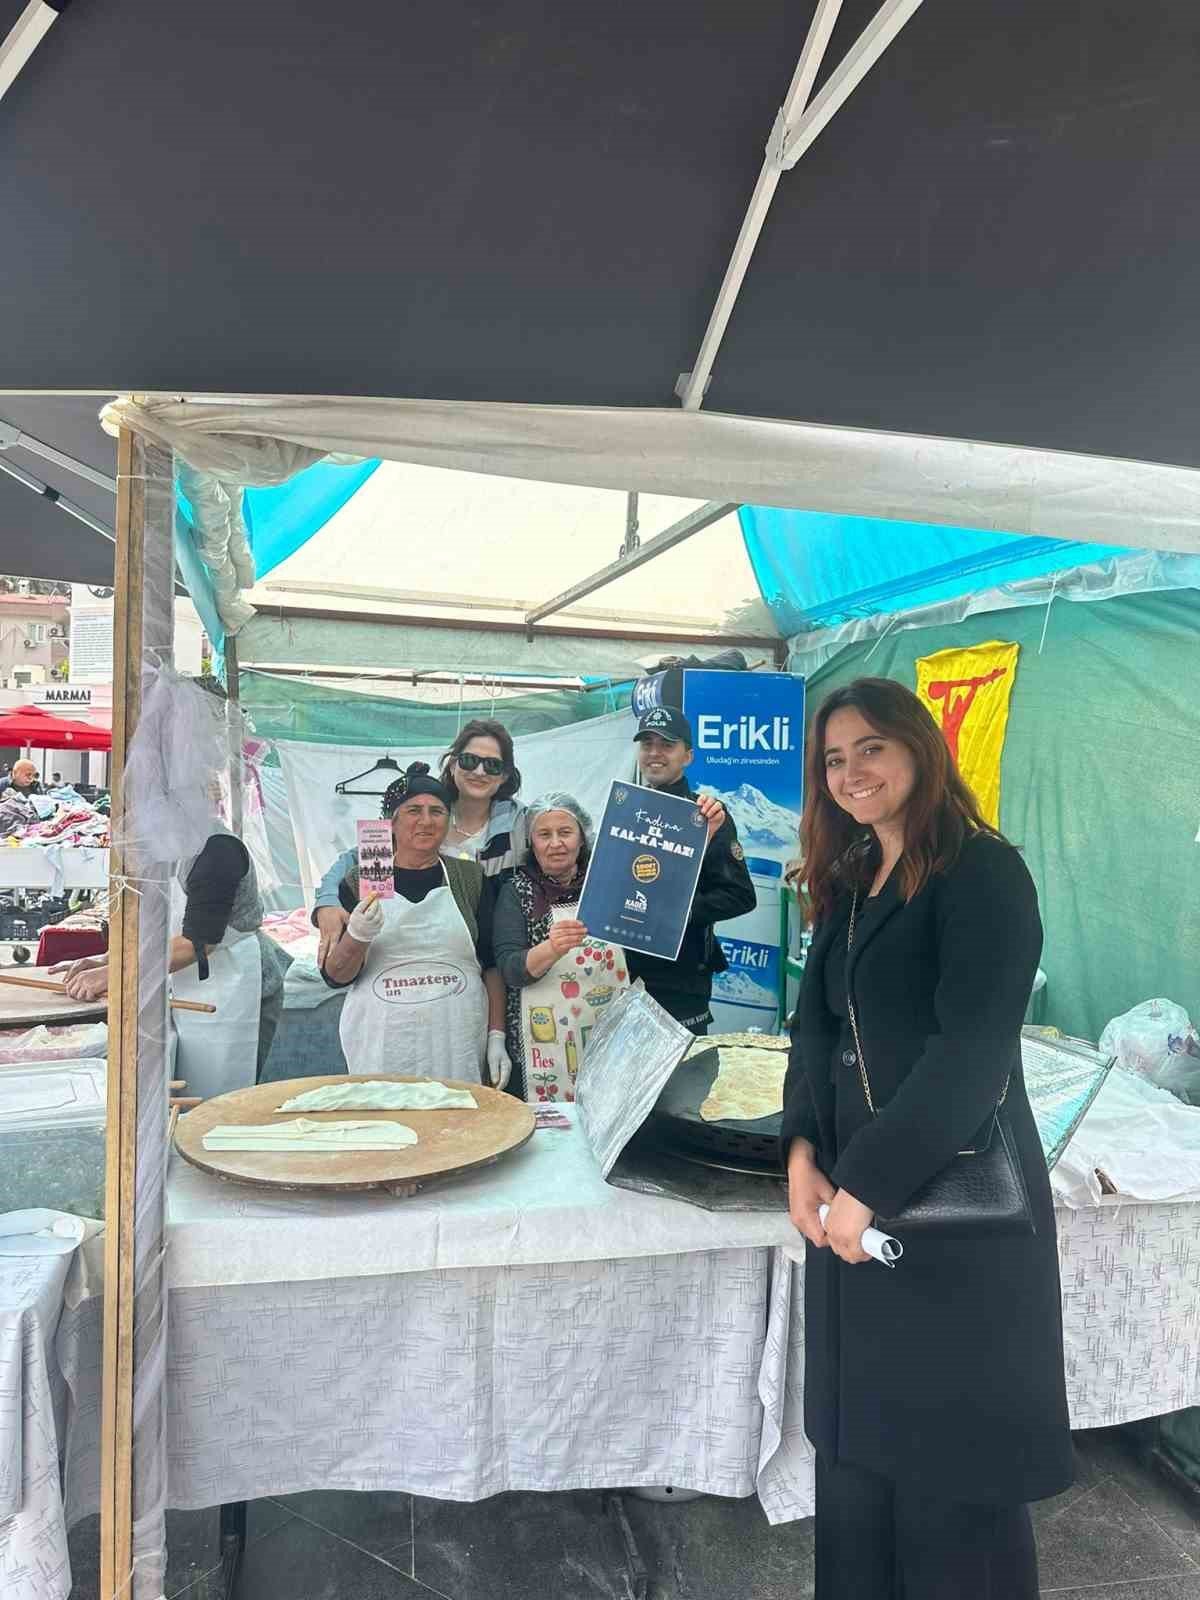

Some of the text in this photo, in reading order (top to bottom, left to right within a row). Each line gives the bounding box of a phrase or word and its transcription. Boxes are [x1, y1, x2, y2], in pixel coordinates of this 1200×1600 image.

[697, 714, 791, 751] Erikli
[648, 826, 664, 838] EL
[721, 942, 769, 969] Erikli
[531, 1047, 555, 1069] Pies
